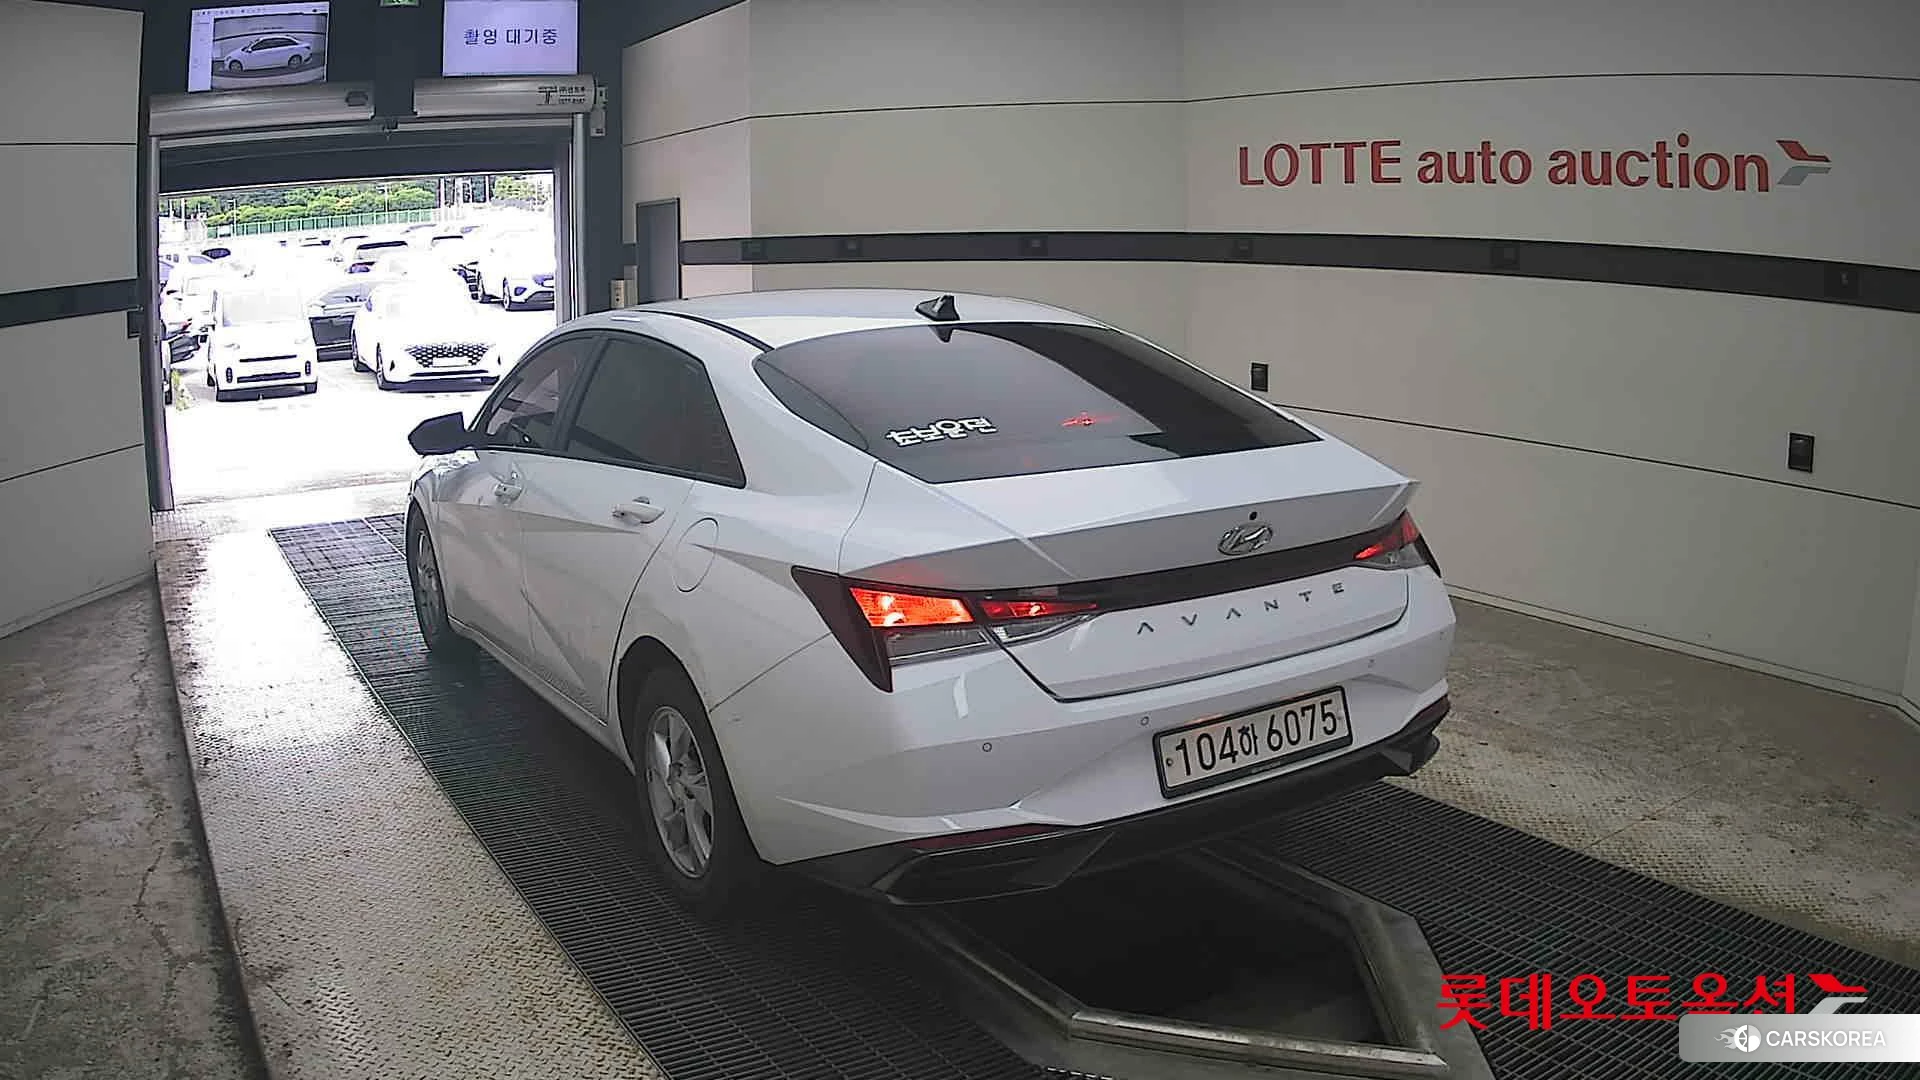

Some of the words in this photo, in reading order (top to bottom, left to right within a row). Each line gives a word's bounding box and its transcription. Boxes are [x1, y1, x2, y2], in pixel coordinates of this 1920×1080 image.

[463, 28, 497, 45] 촬영
[505, 28, 559, 45] 대기중
[1238, 139, 1402, 187] LOTTE
[1417, 140, 1533, 186] auto
[1547, 132, 1771, 193] auction
[1136, 581, 1346, 635] AVANTE
[1175, 721, 1260, 777] 104하
[1266, 698, 1339, 753] 6075
